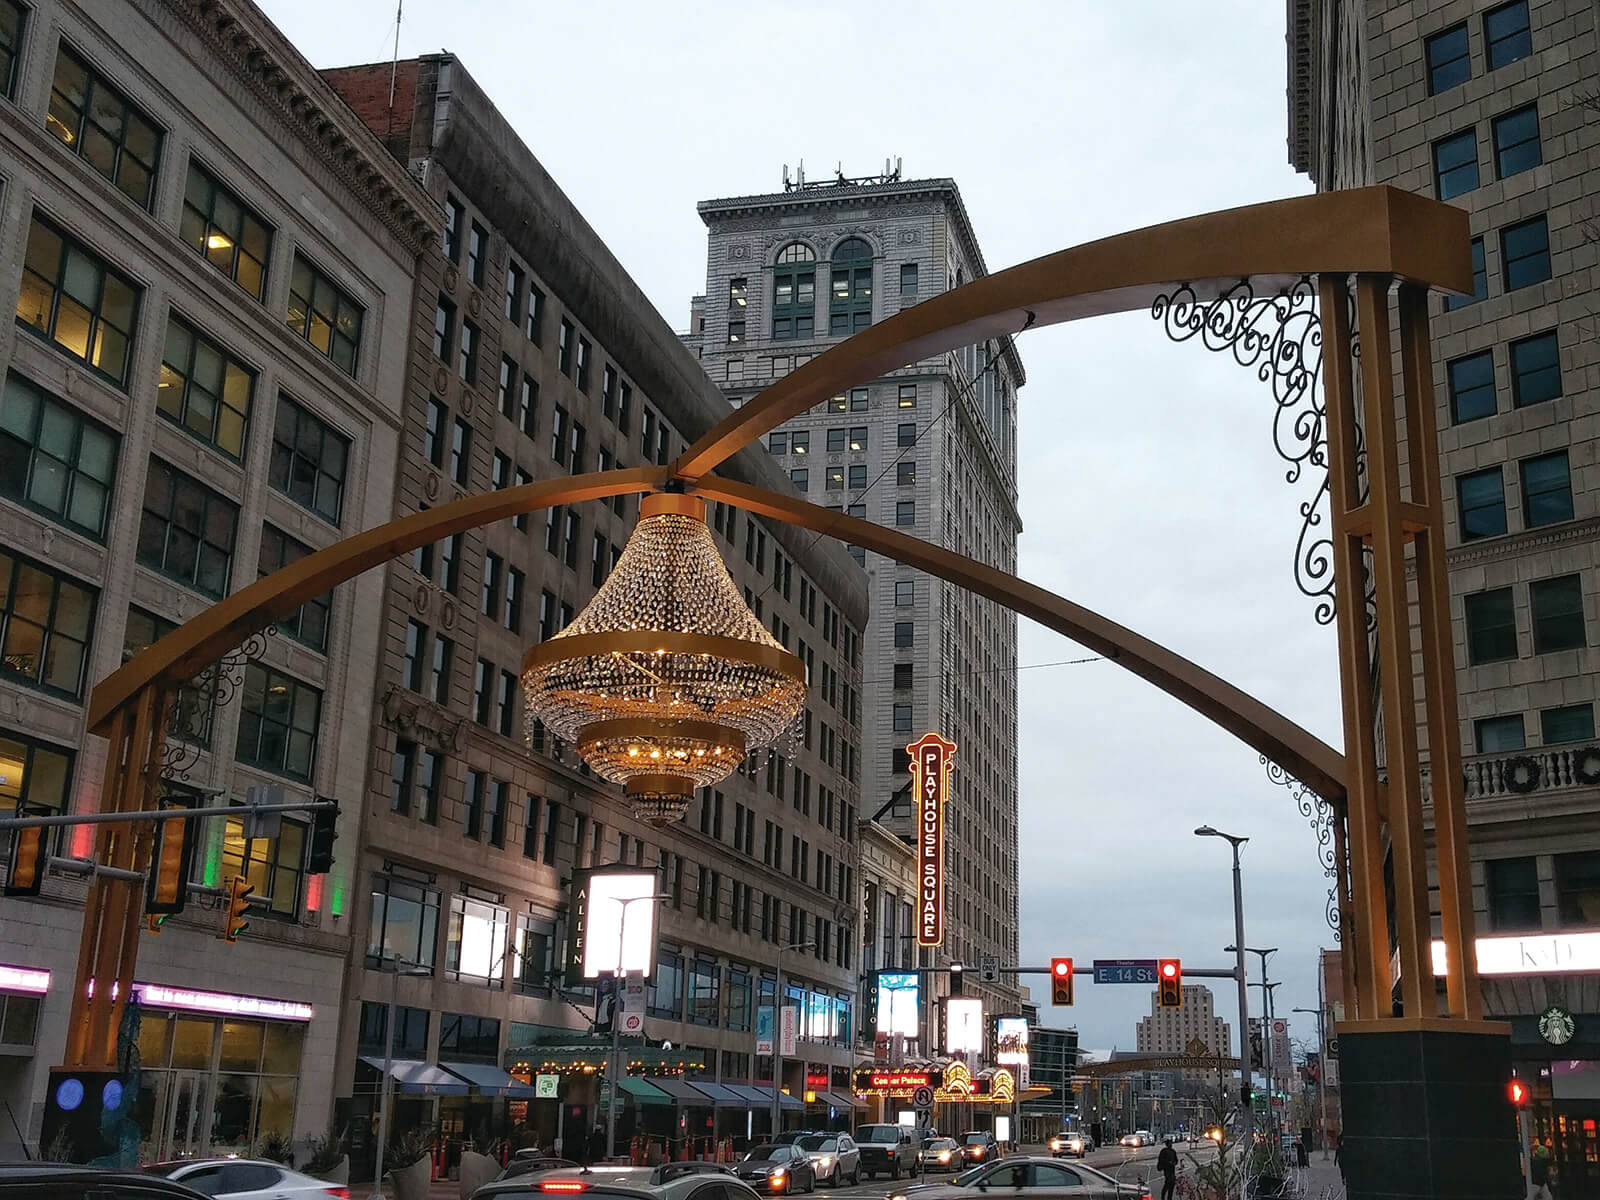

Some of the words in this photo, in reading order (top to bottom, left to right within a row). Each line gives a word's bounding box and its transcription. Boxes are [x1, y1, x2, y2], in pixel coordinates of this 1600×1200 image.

[924, 753, 937, 857] PLAYHOUSE
[573, 889, 586, 964] ALLEN
[924, 863, 936, 937] SQUARE
[1099, 969, 1112, 982] E.
[1117, 968, 1133, 981] 14
[1137, 968, 1153, 981] St
[869, 987, 878, 1024] OHIO
[1155, 1055, 1203, 1067] PLAYHOUSE
